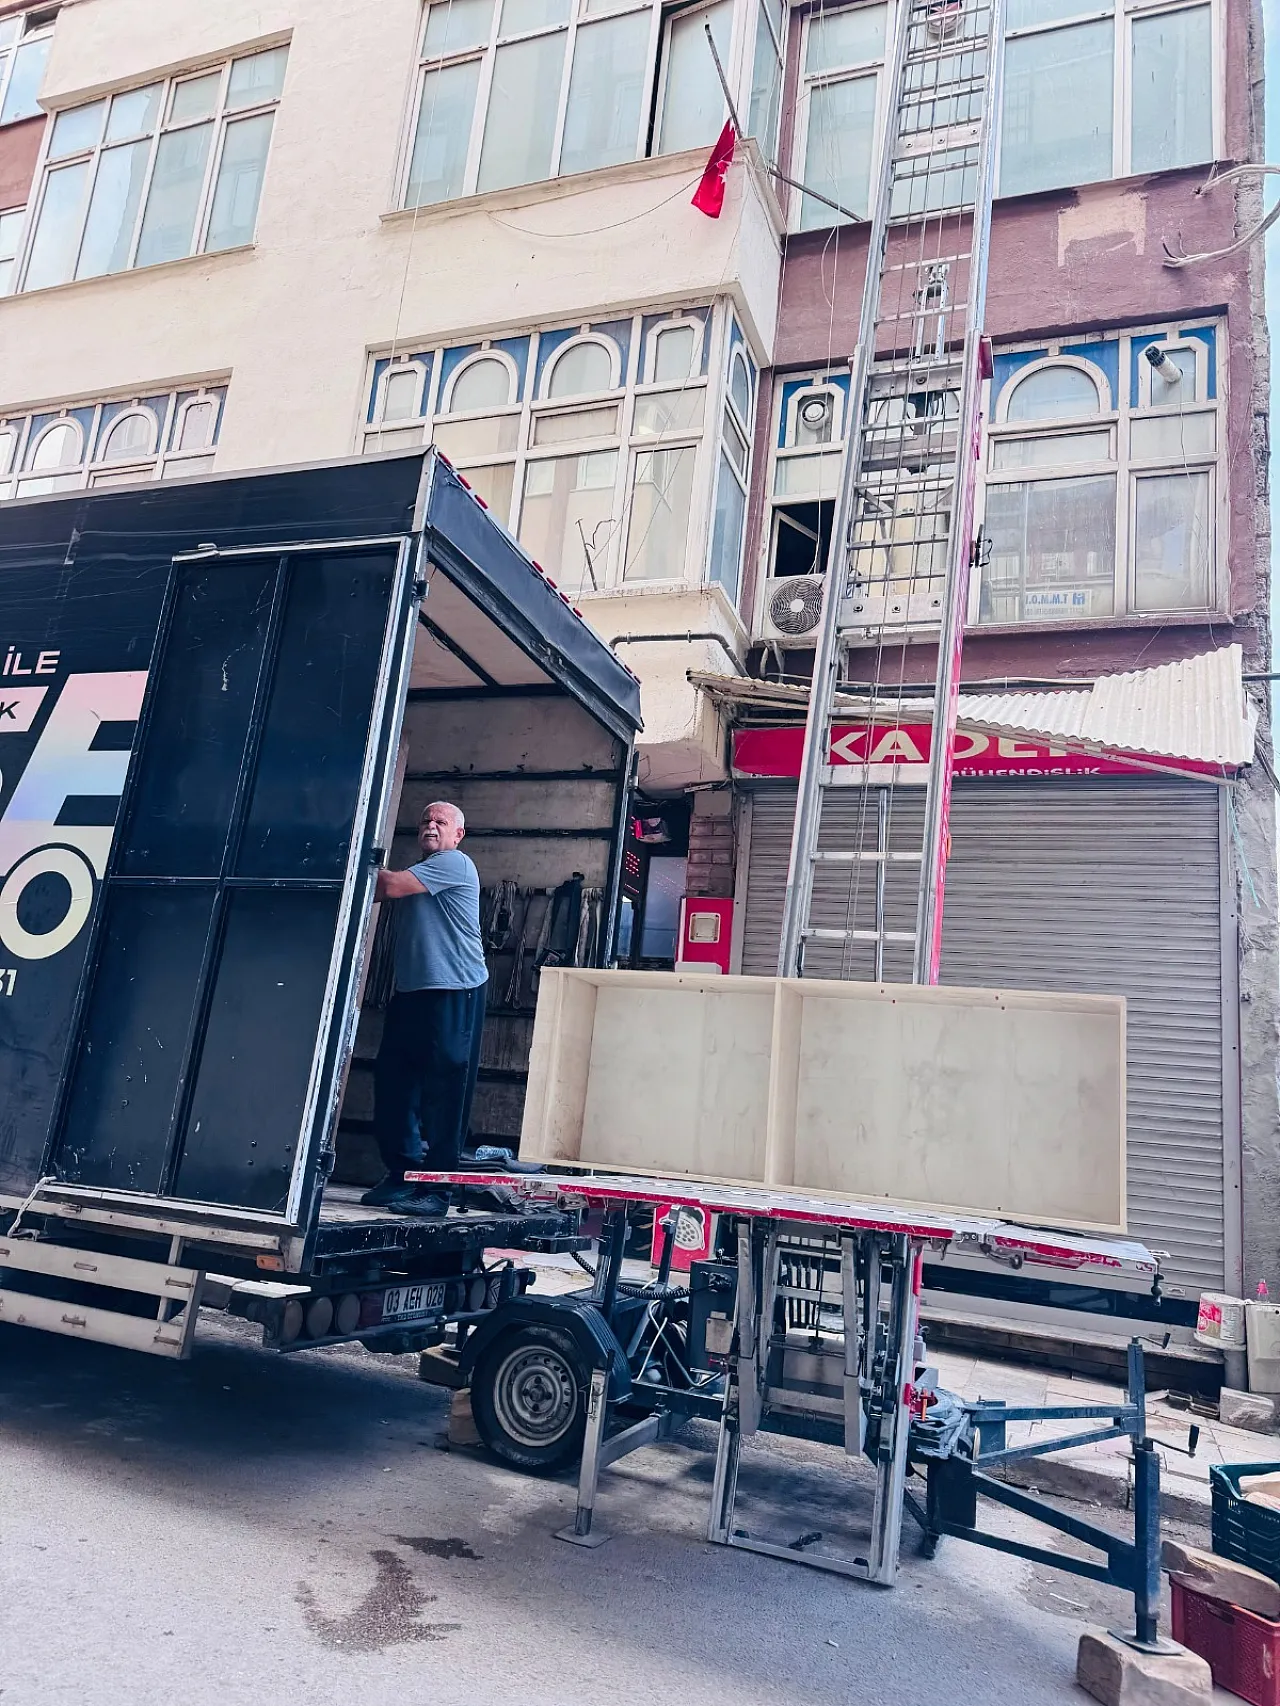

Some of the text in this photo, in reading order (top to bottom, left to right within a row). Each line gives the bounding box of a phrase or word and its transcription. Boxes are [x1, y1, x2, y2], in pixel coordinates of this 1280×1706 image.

[2, 646, 60, 675] İLE
[386, 1290, 400, 1313] 03
[426, 1285, 444, 1307] 028
